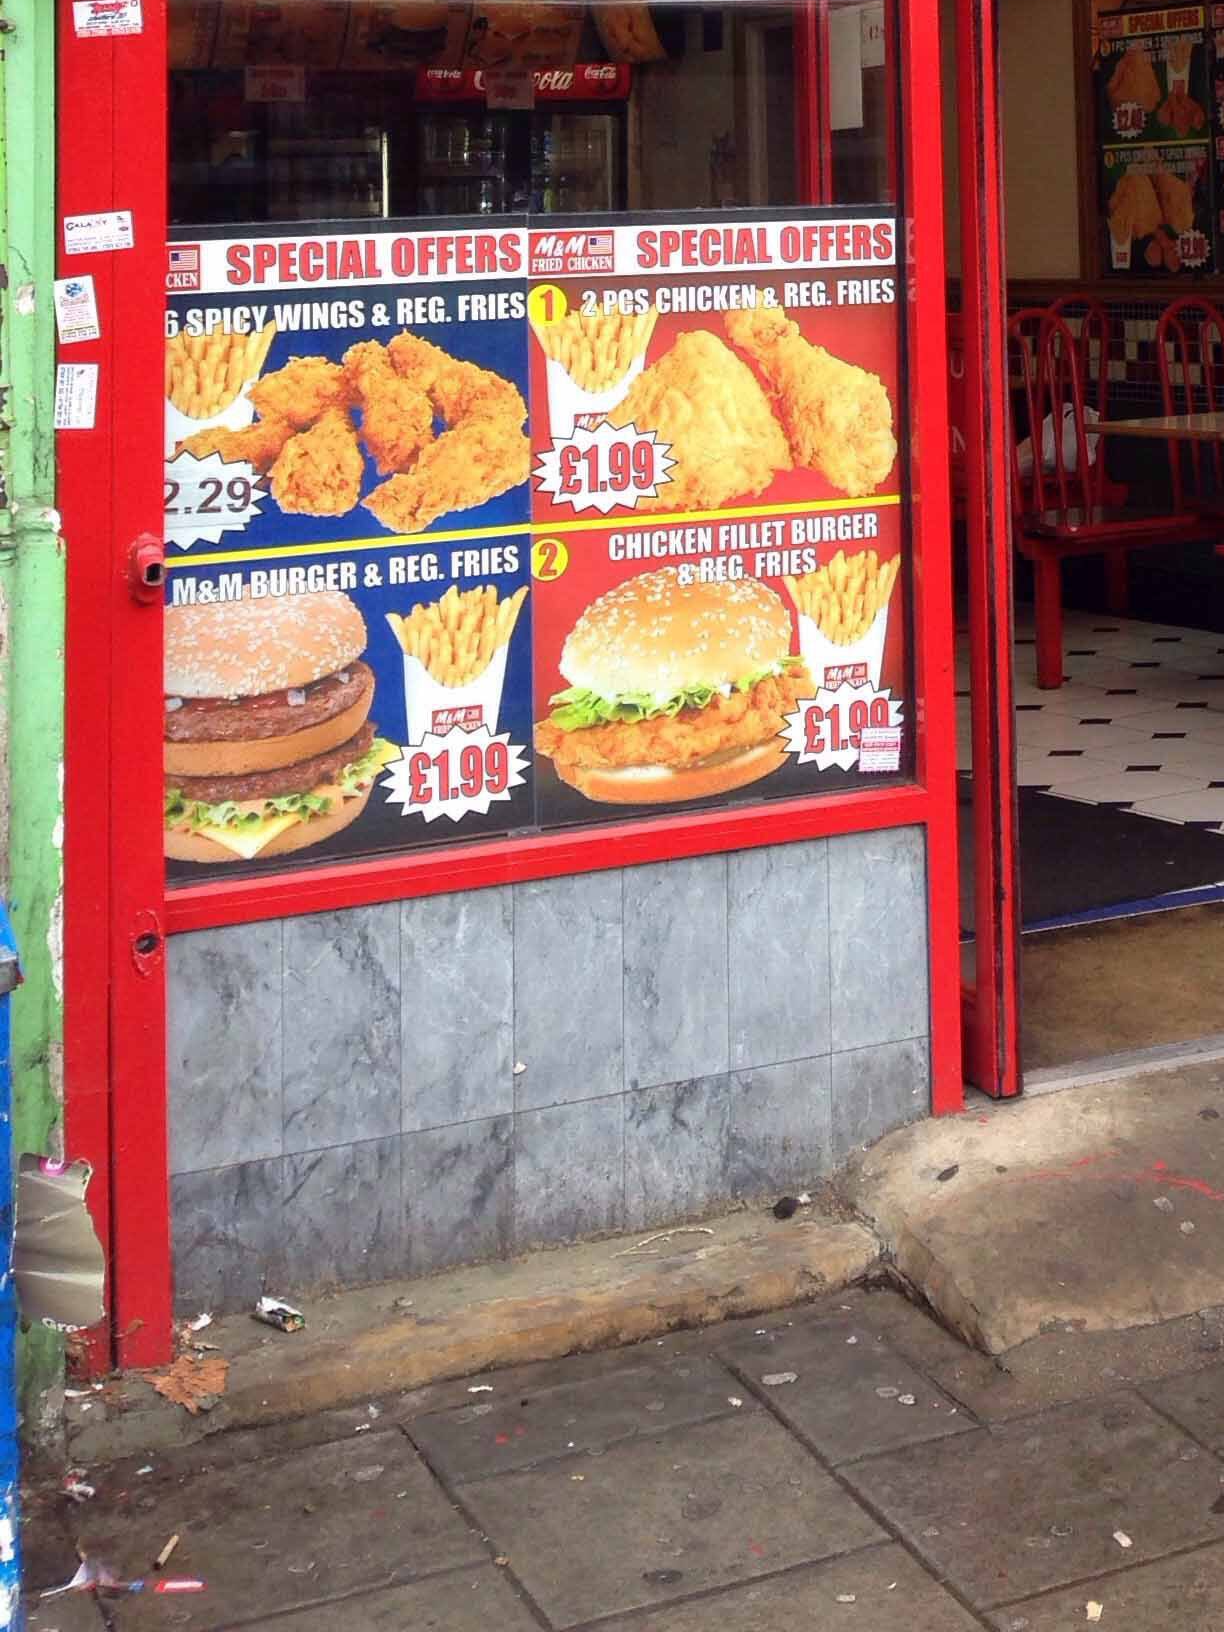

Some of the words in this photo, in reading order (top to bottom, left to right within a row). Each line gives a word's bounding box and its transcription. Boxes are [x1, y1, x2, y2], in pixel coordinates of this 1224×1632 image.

[226, 239, 381, 286] SPECIAL
[391, 233, 522, 278] OFFERS
[531, 255, 563, 272] FRIED
[567, 253, 613, 271] CHICKEN
[534, 234, 587, 257] M&M
[636, 229, 772, 269] SPECIAL
[780, 223, 894, 264] OFFERS
[164, 308, 180, 339] 6
[185, 304, 268, 337] SPICY
[274, 299, 365, 333] WINGS
[371, 303, 391, 327] &
[396, 295, 452, 325] REG.
[457, 292, 526, 323] FRIES
[540, 288, 553, 322] 1
[581, 290, 597, 318] 2
[603, 288, 649, 315] PCS
[655, 282, 758, 314] CHICKEN
[763, 287, 780, 309] &
[784, 281, 832, 307] REG.
[837, 279, 896, 306] FRIES
[558, 441, 655, 495] £1.99
[538, 542, 557, 577] 2
[608, 527, 712, 561] CHICKEN
[718, 520, 786, 553] FILLET
[791, 512, 878, 546] BURGER
[172, 575, 242, 607] M&M
[249, 566, 358, 601] BURGER
[364, 562, 383, 587] &
[388, 554, 446, 585] REG.
[450, 545, 521, 577] FRIES
[676, 562, 695, 586] &
[754, 548, 818, 578] FRIES
[803, 697, 889, 755] £1.99
[407, 741, 510, 806] £1.99
